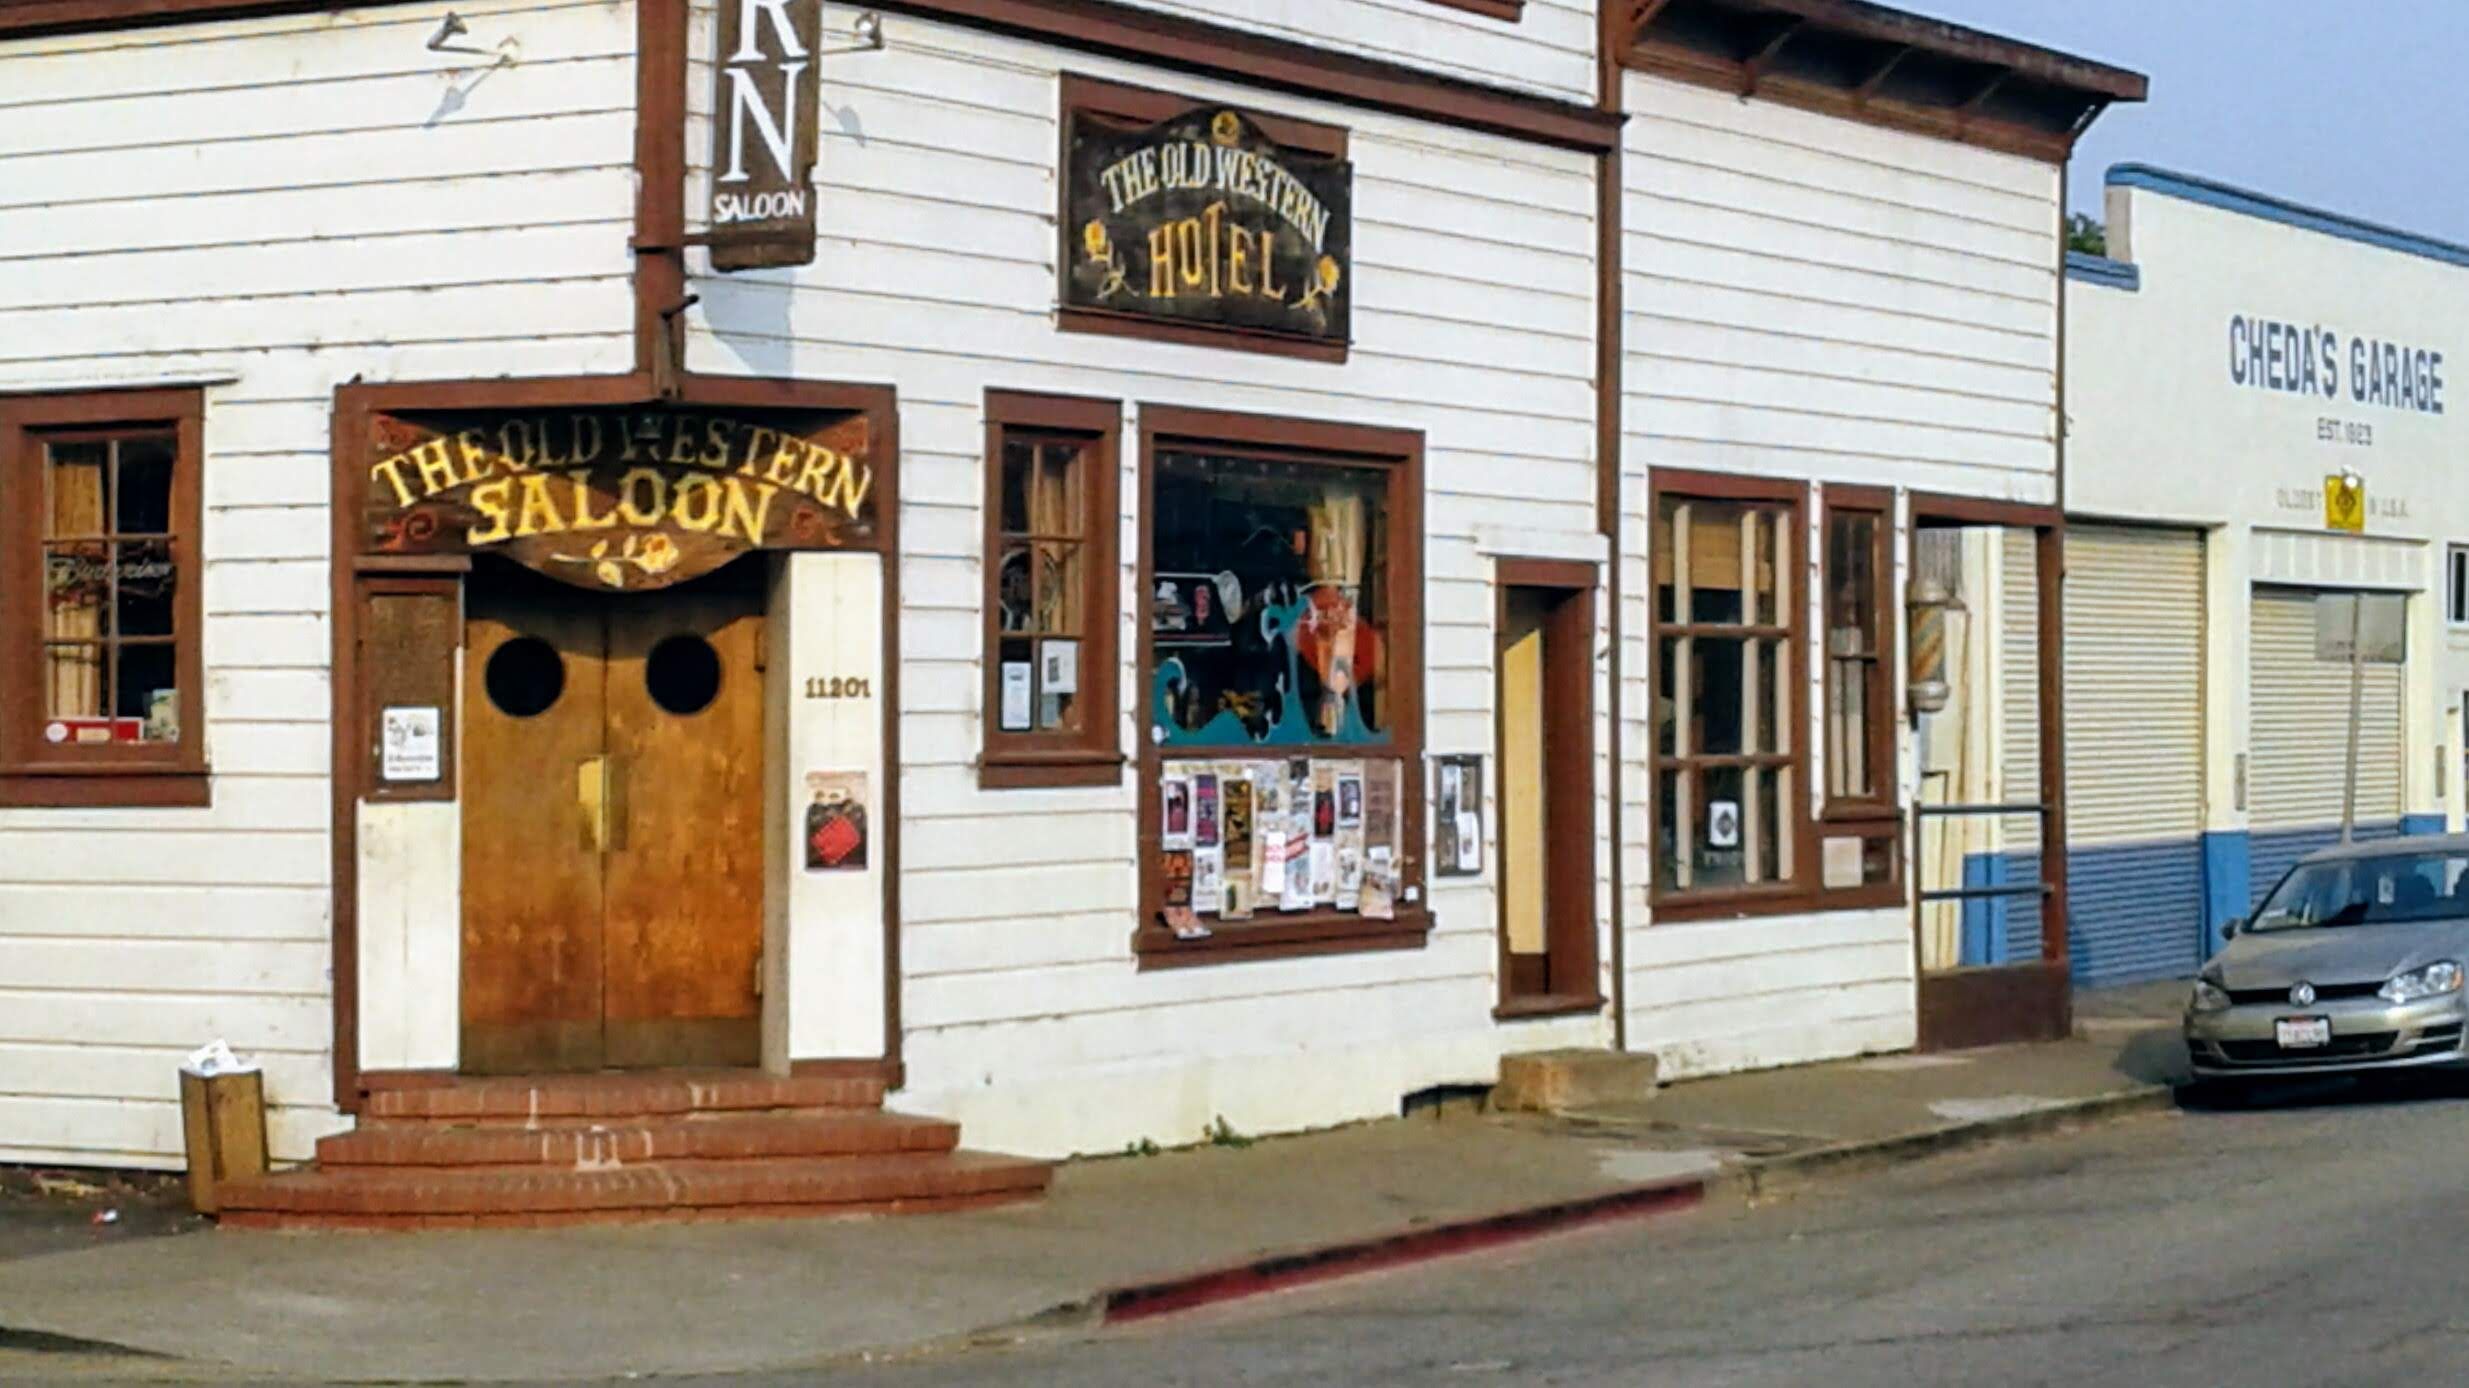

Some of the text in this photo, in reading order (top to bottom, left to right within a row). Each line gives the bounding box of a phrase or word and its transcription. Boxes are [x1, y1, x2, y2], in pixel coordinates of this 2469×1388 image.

[713, 189, 806, 224] SALOON
[1100, 141, 1332, 254] THE OLD WESTERN
[1147, 200, 1288, 300] HOTEL
[2230, 314, 2444, 415] CHEDA'S GARAGE
[371, 413, 874, 521] THE OLD WESTERN
[466, 465, 780, 547] SALOON
[804, 676, 871, 699] 11201
